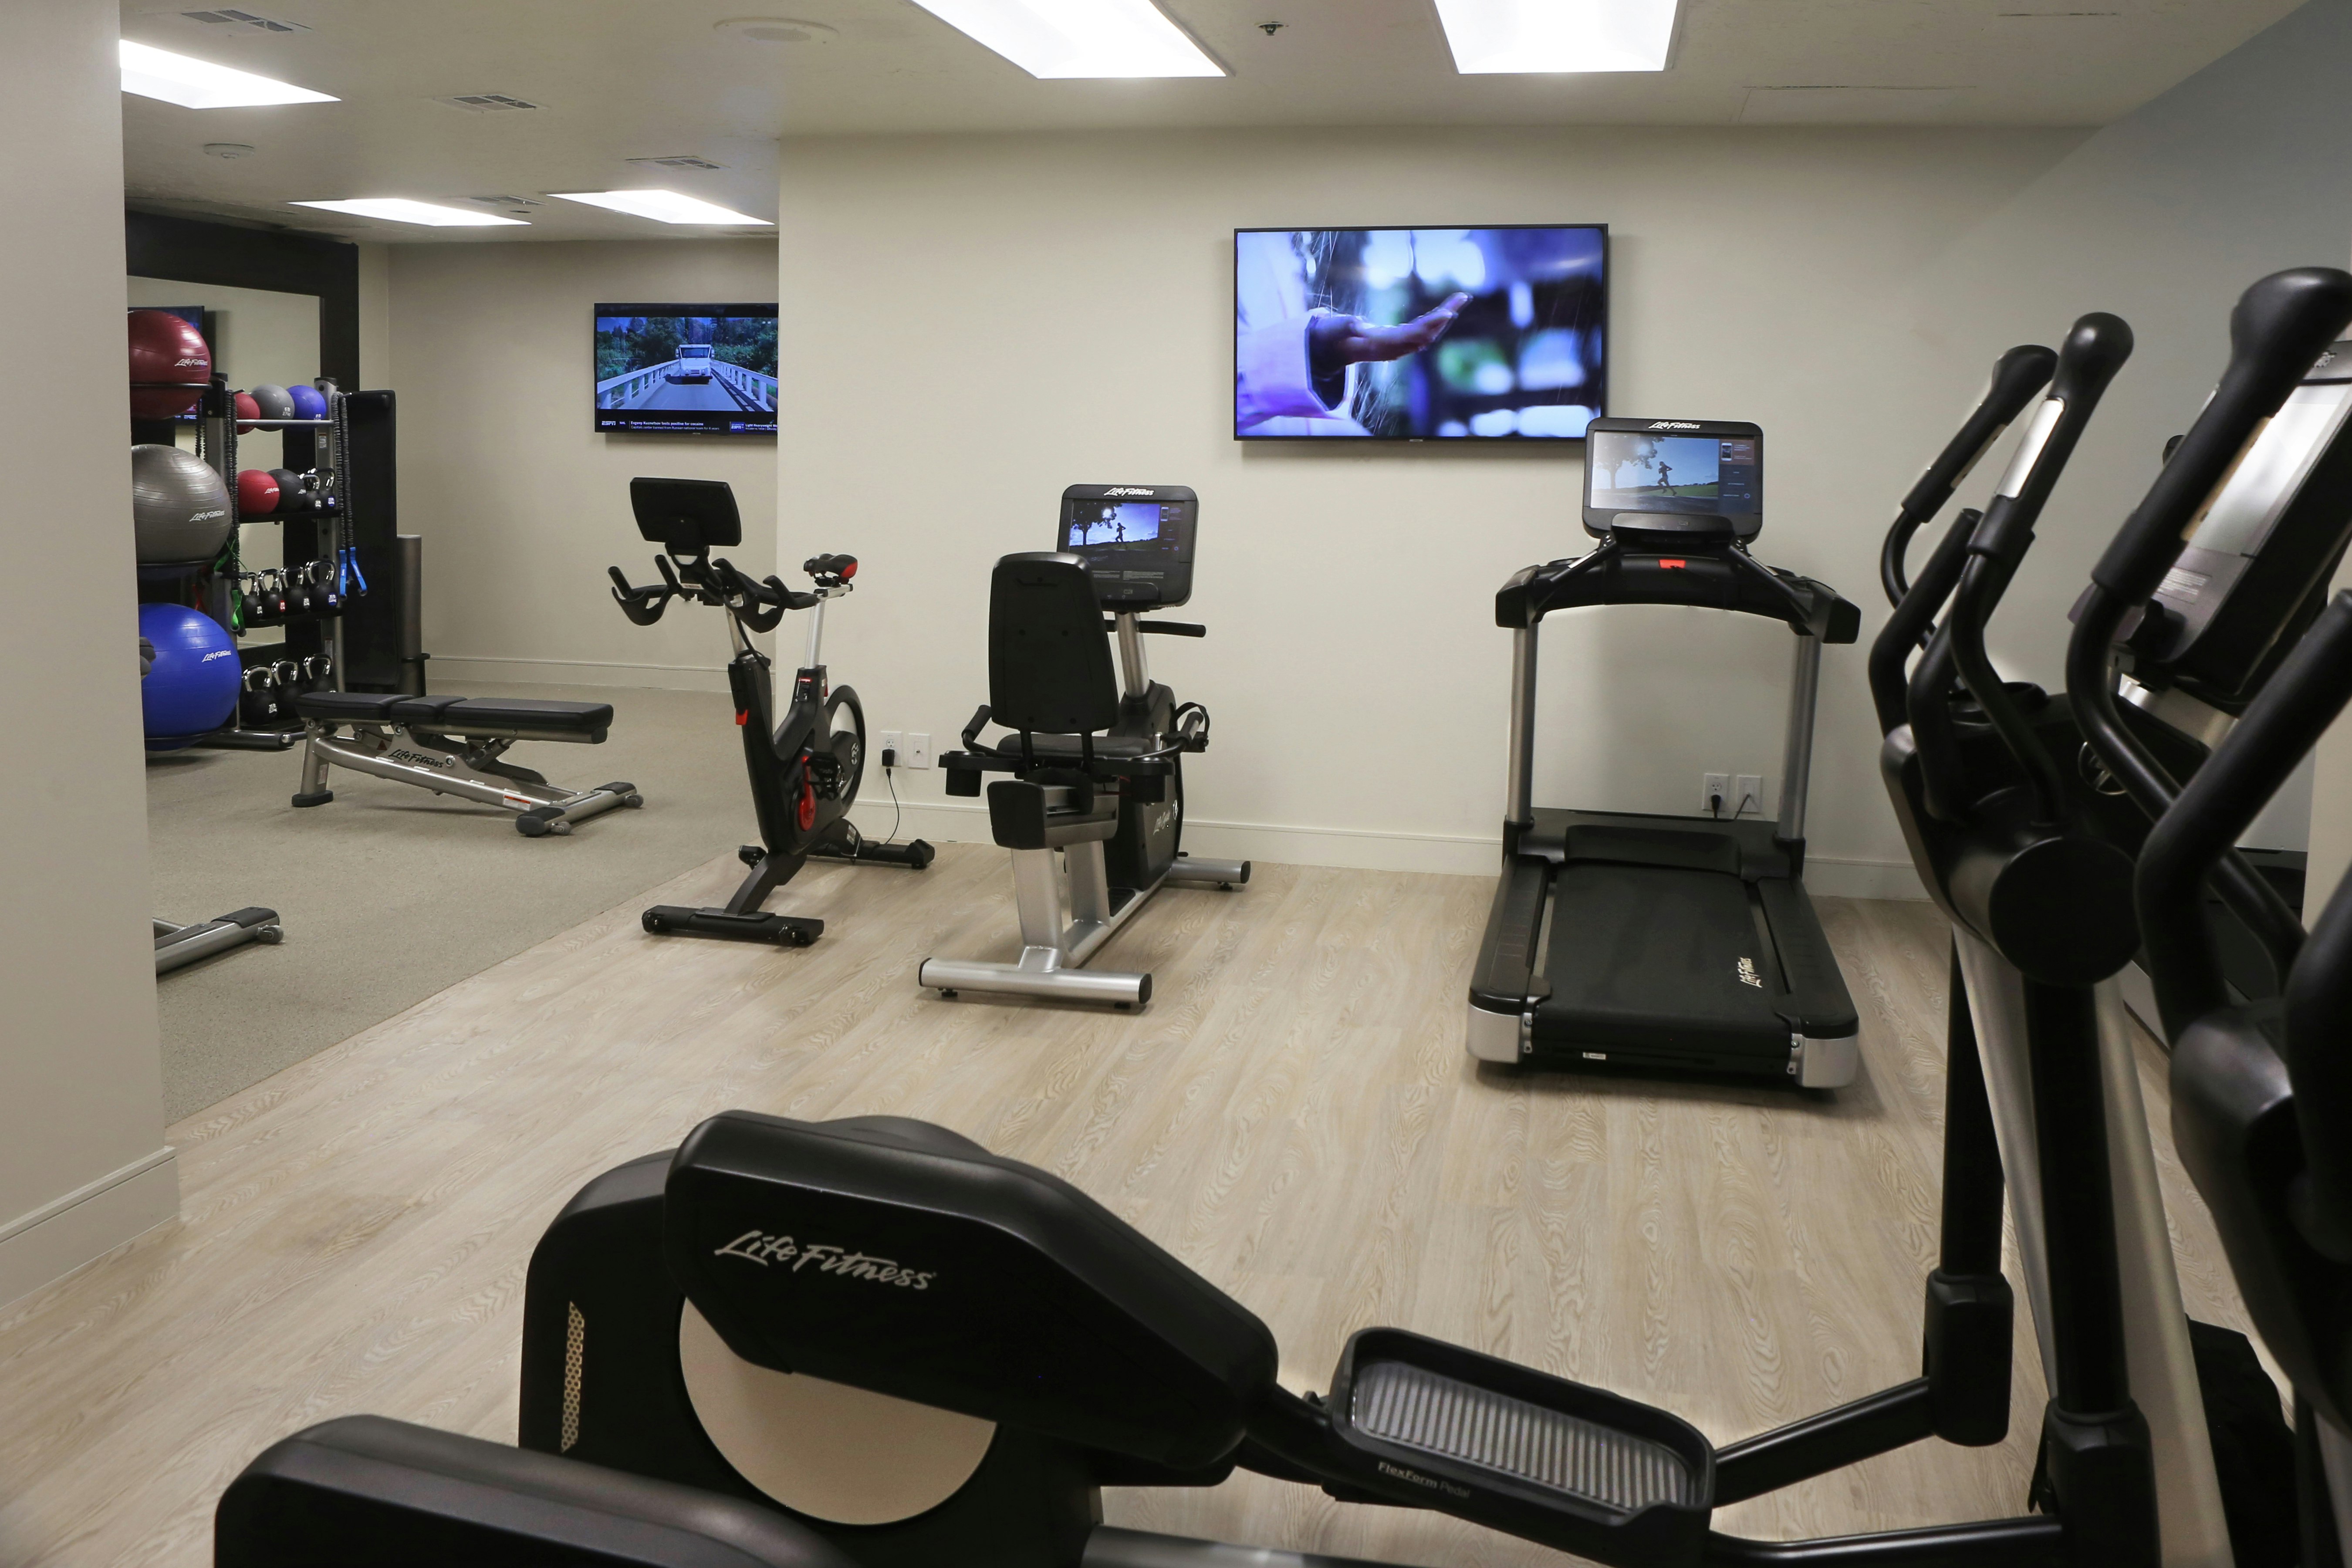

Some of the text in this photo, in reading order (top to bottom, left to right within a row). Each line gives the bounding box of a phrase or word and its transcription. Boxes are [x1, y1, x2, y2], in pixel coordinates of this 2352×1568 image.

[388, 749, 444, 768] Life Fitness
[714, 1230, 933, 1290] Life Fitness
[1378, 1461, 1470, 1499] FlexForm Pedal
